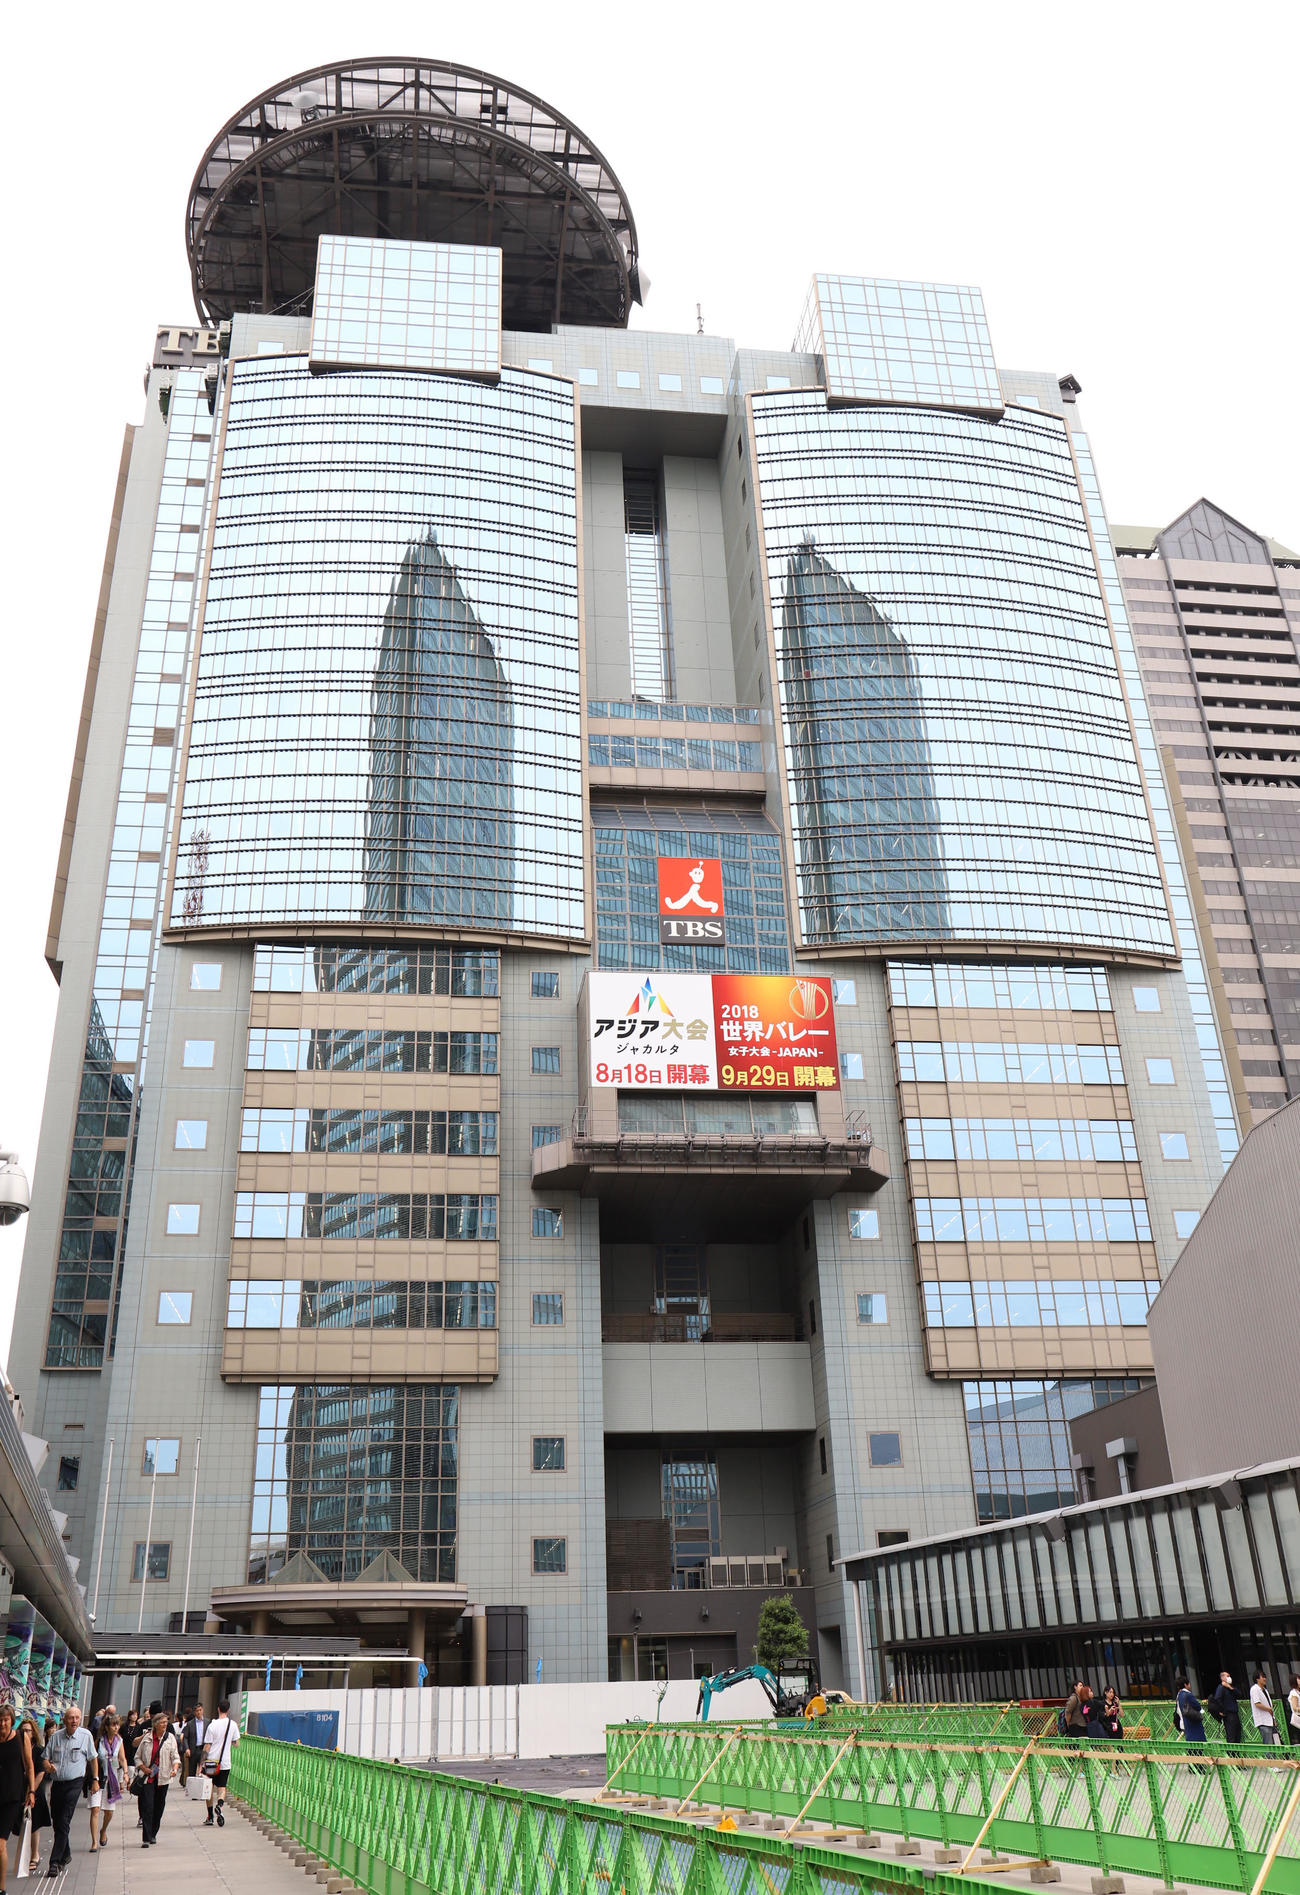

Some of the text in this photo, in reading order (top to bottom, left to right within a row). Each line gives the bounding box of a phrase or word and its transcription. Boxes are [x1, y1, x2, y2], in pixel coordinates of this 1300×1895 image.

[157, 327, 220, 355] TB
[663, 921, 723, 938] TBS
[721, 1004, 759, 1019] 2018
[594, 1018, 709, 1041] アジア大会
[720, 1021, 829, 1042] 世界バレー
[616, 1043, 679, 1055] ジャカルタ
[667, 1064, 710, 1084] 開幕
[794, 1067, 836, 1087] 開幕
